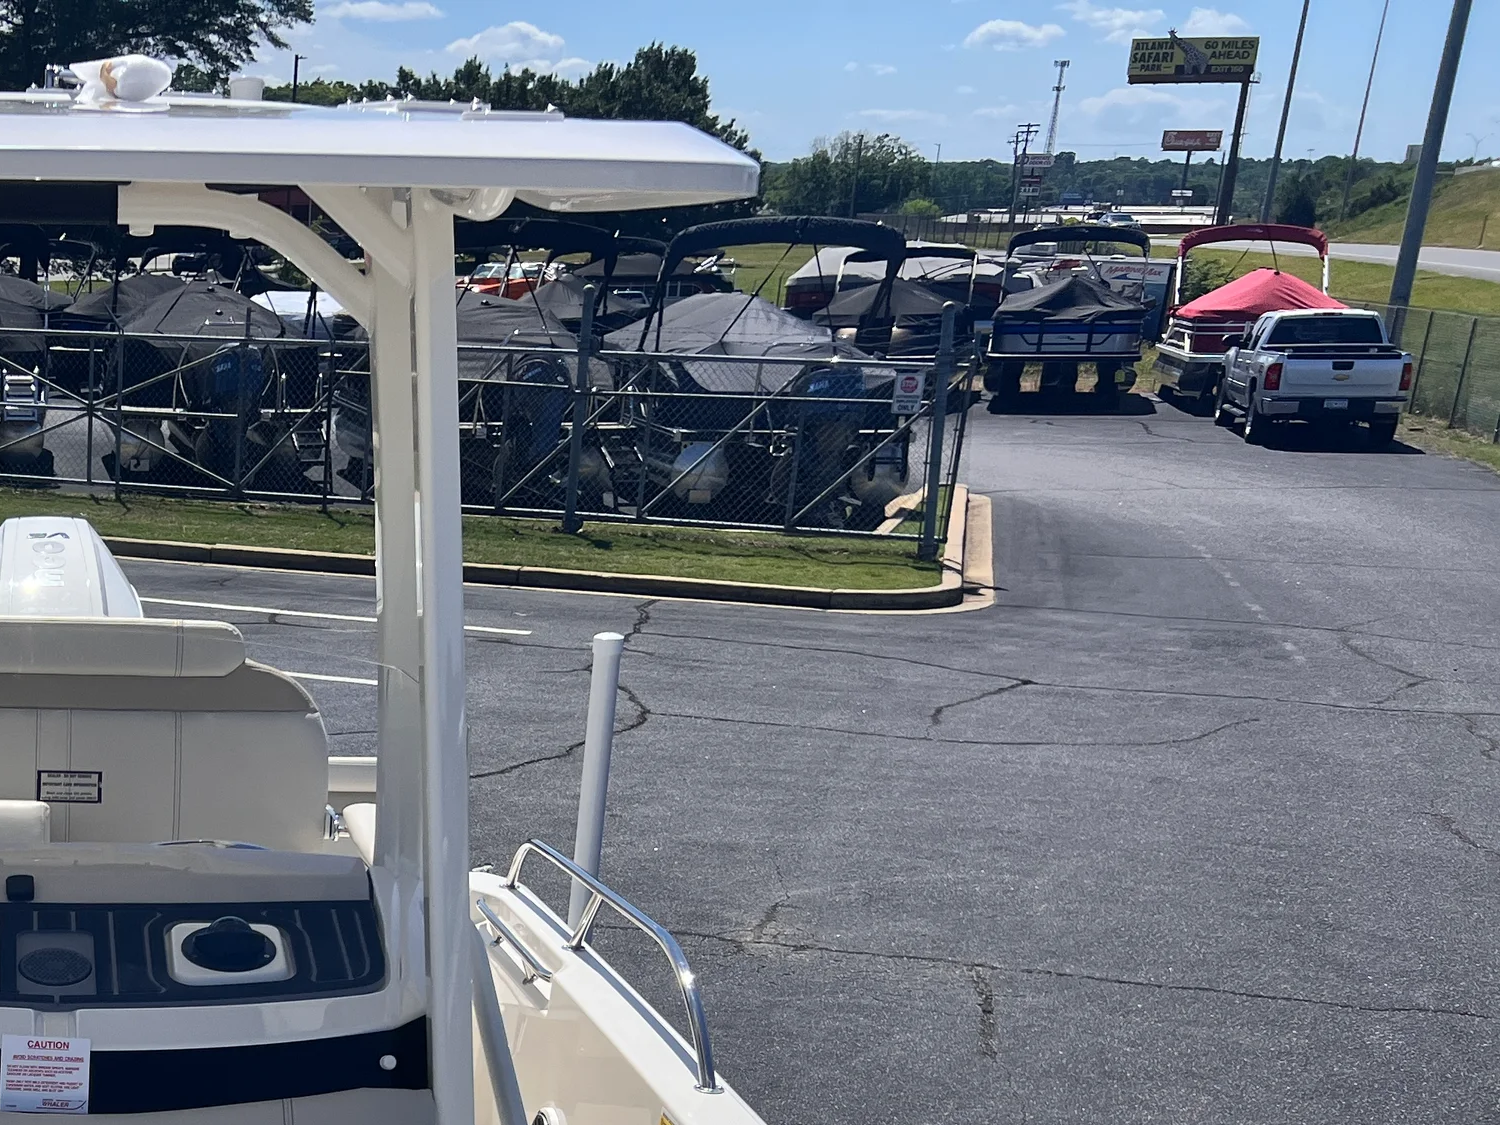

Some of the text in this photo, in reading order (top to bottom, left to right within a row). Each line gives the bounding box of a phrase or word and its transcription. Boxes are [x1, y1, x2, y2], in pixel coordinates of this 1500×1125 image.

[1134, 41, 1175, 51] ATLANTA
[1204, 40, 1255, 50] 60 MILES
[1132, 51, 1174, 64] SAFARI
[1209, 50, 1250, 60] AHEAD
[1139, 64, 1162, 73] PARK
[1211, 65, 1229, 73] EXIT
[27, 1040, 70, 1050] CAUTION
